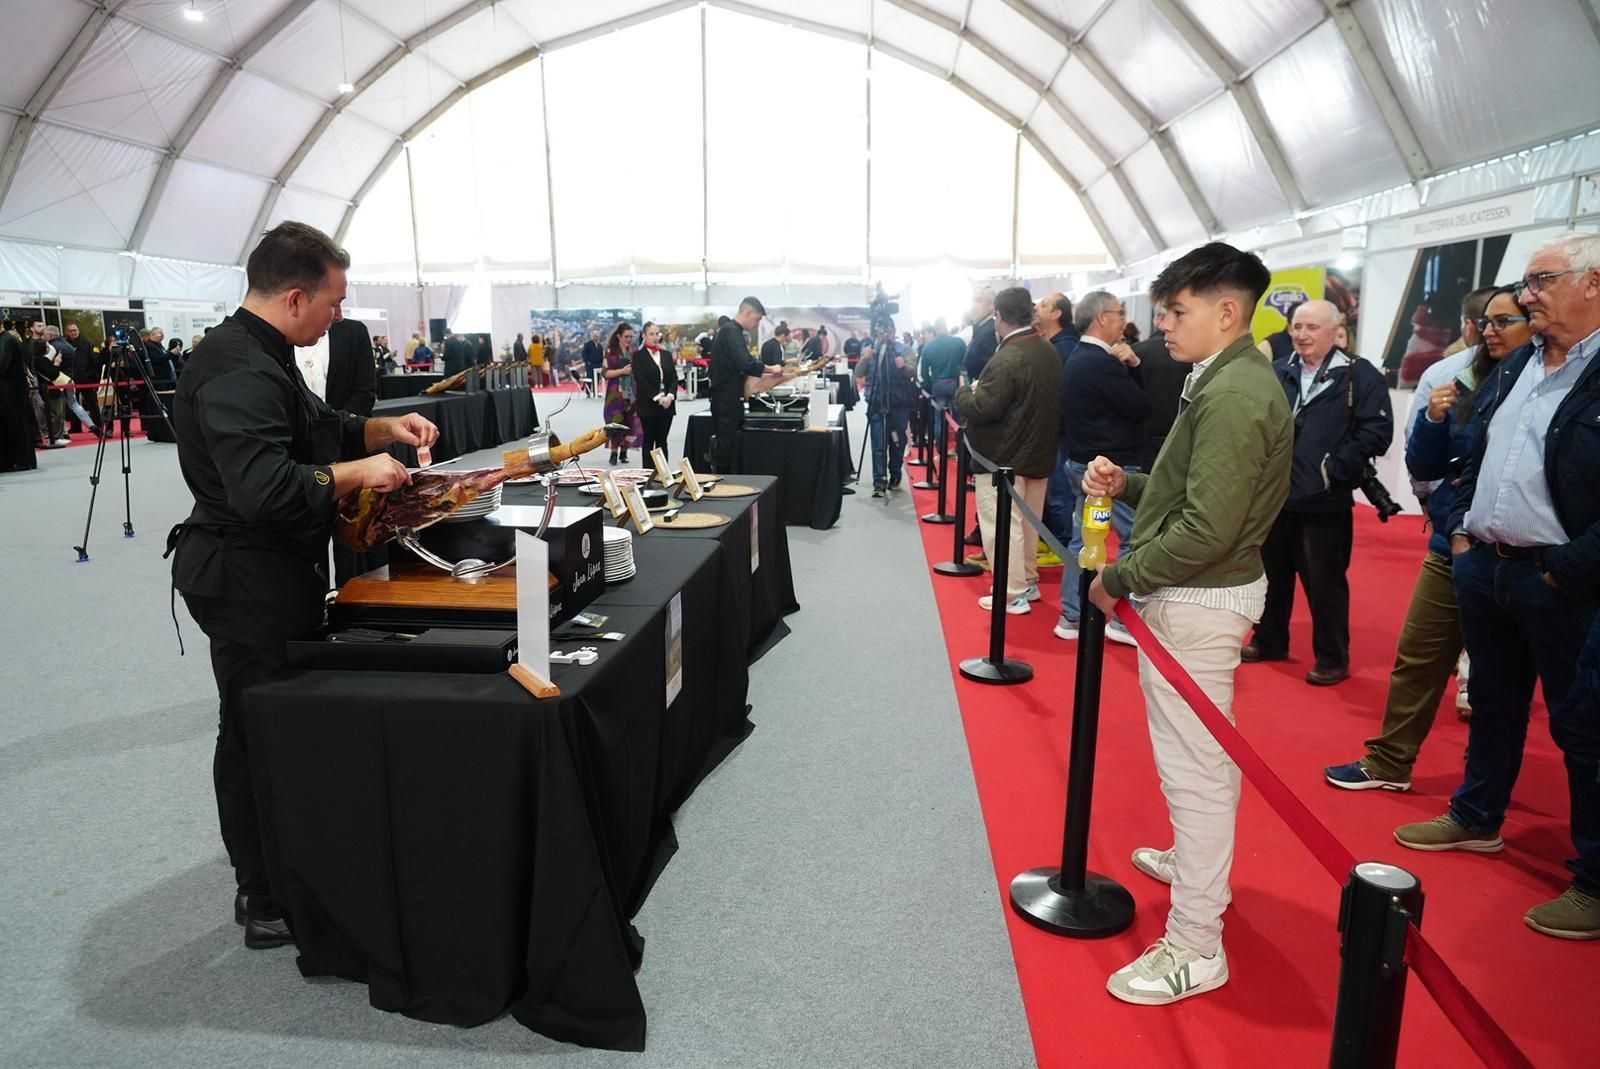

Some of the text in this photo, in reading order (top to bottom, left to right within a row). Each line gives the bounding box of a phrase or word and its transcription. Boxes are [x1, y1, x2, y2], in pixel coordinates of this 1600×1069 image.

[1456, 205, 1512, 227] DELICATESSEN
[1092, 509, 1113, 520] FANT
[572, 560, 601, 593] Juan López
